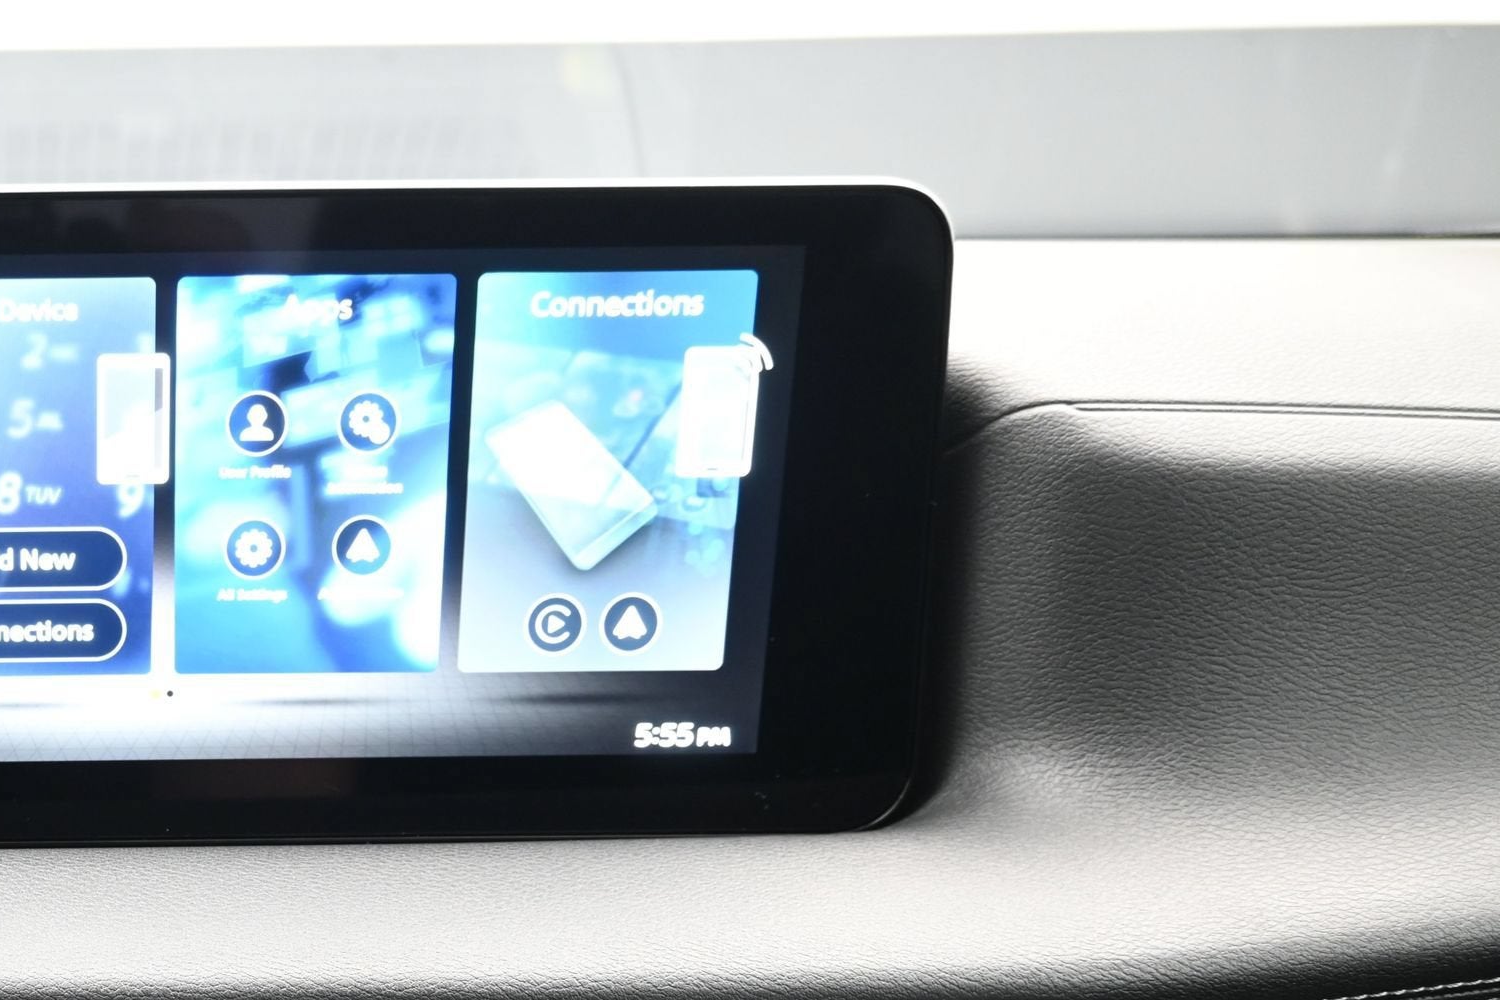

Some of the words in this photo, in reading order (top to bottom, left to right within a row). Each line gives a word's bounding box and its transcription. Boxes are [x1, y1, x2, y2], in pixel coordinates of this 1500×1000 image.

[530, 289, 705, 318] Connections
[19, 547, 77, 571] New
[633, 721, 695, 748] 5:55
[696, 726, 732, 747] PM
